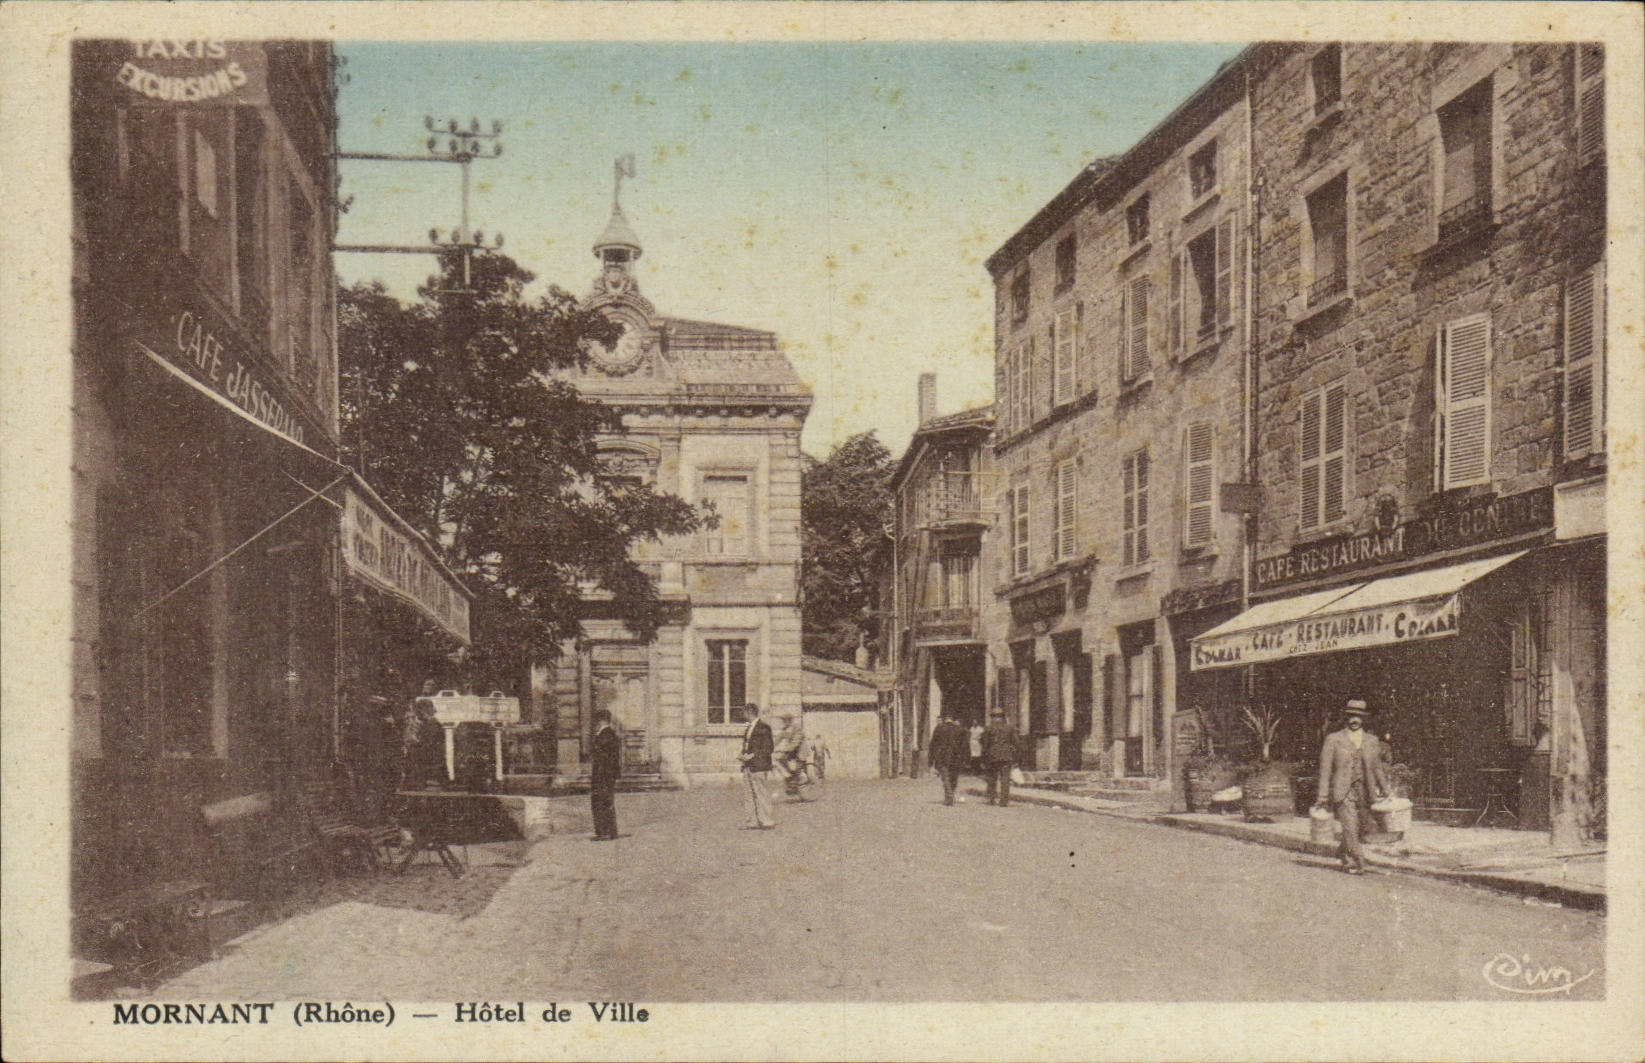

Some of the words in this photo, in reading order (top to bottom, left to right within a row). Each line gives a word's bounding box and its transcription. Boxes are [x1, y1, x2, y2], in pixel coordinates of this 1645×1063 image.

[134, 39, 227, 59] TAXIS
[116, 61, 248, 101] EXCURSIONS
[1257, 556, 1295, 584] CAFE
[1301, 528, 1406, 574] RESTAURANT
[1297, 613, 1383, 643] RESTAURANT
